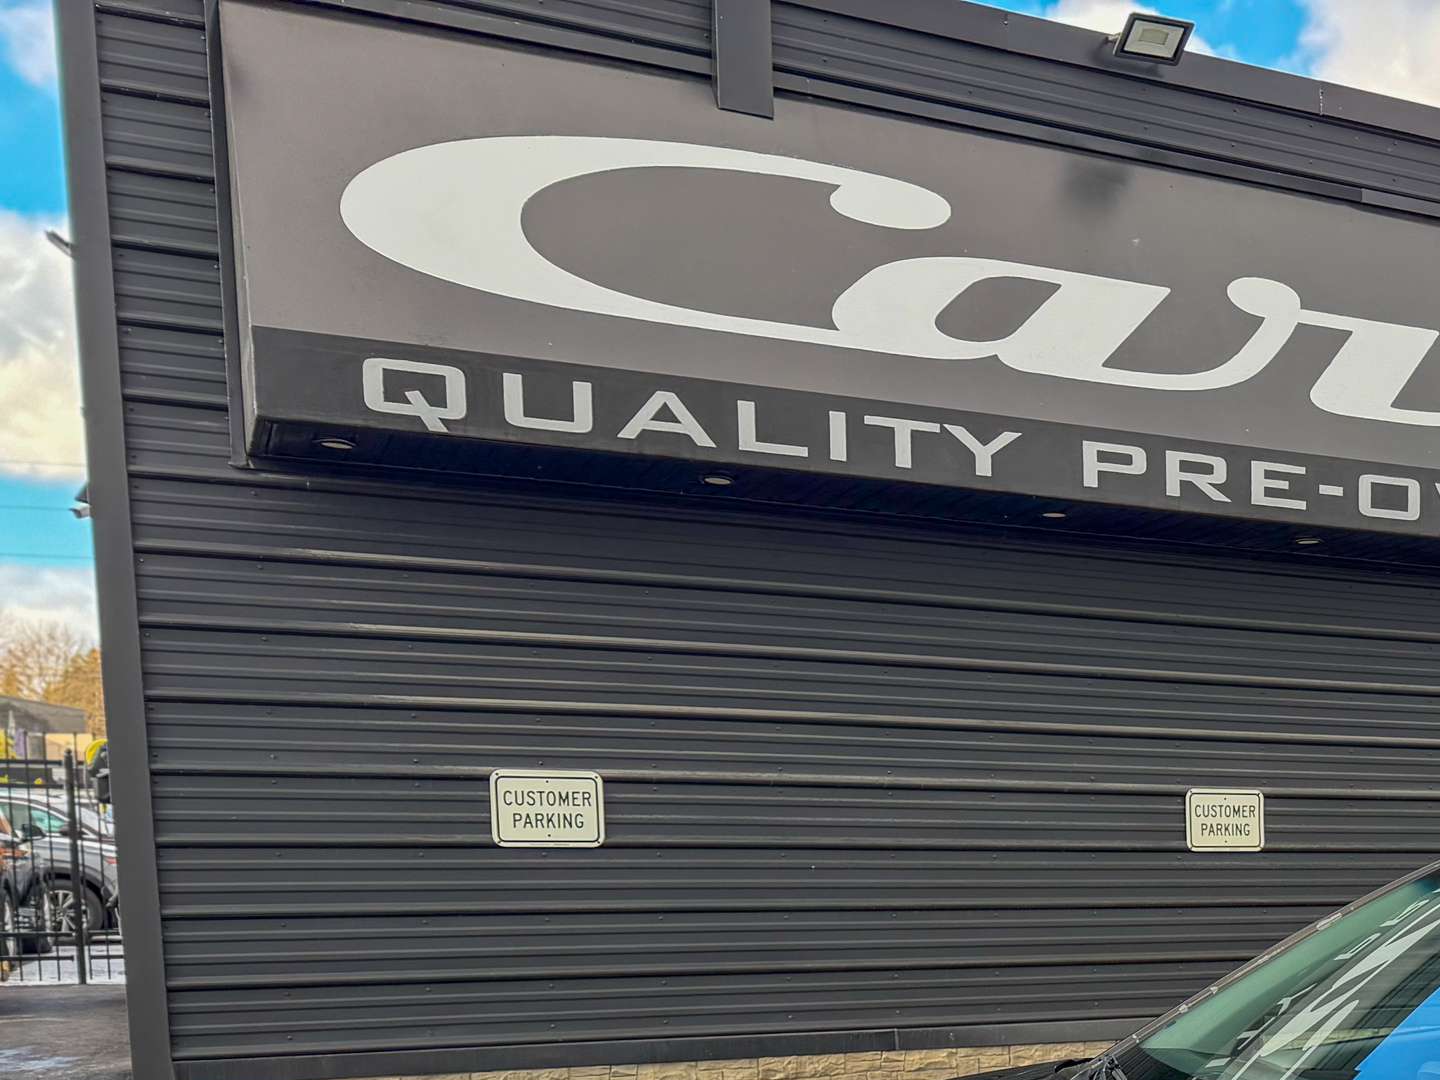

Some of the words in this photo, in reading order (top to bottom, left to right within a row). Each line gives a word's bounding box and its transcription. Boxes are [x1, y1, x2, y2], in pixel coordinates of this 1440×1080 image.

[362, 357, 1022, 477] QUALITY
[503, 790, 592, 807] CUSTOMER
[1194, 804, 1256, 818] CUSTOMER
[513, 812, 584, 829] PARKING
[1200, 823, 1250, 837] PARKING
